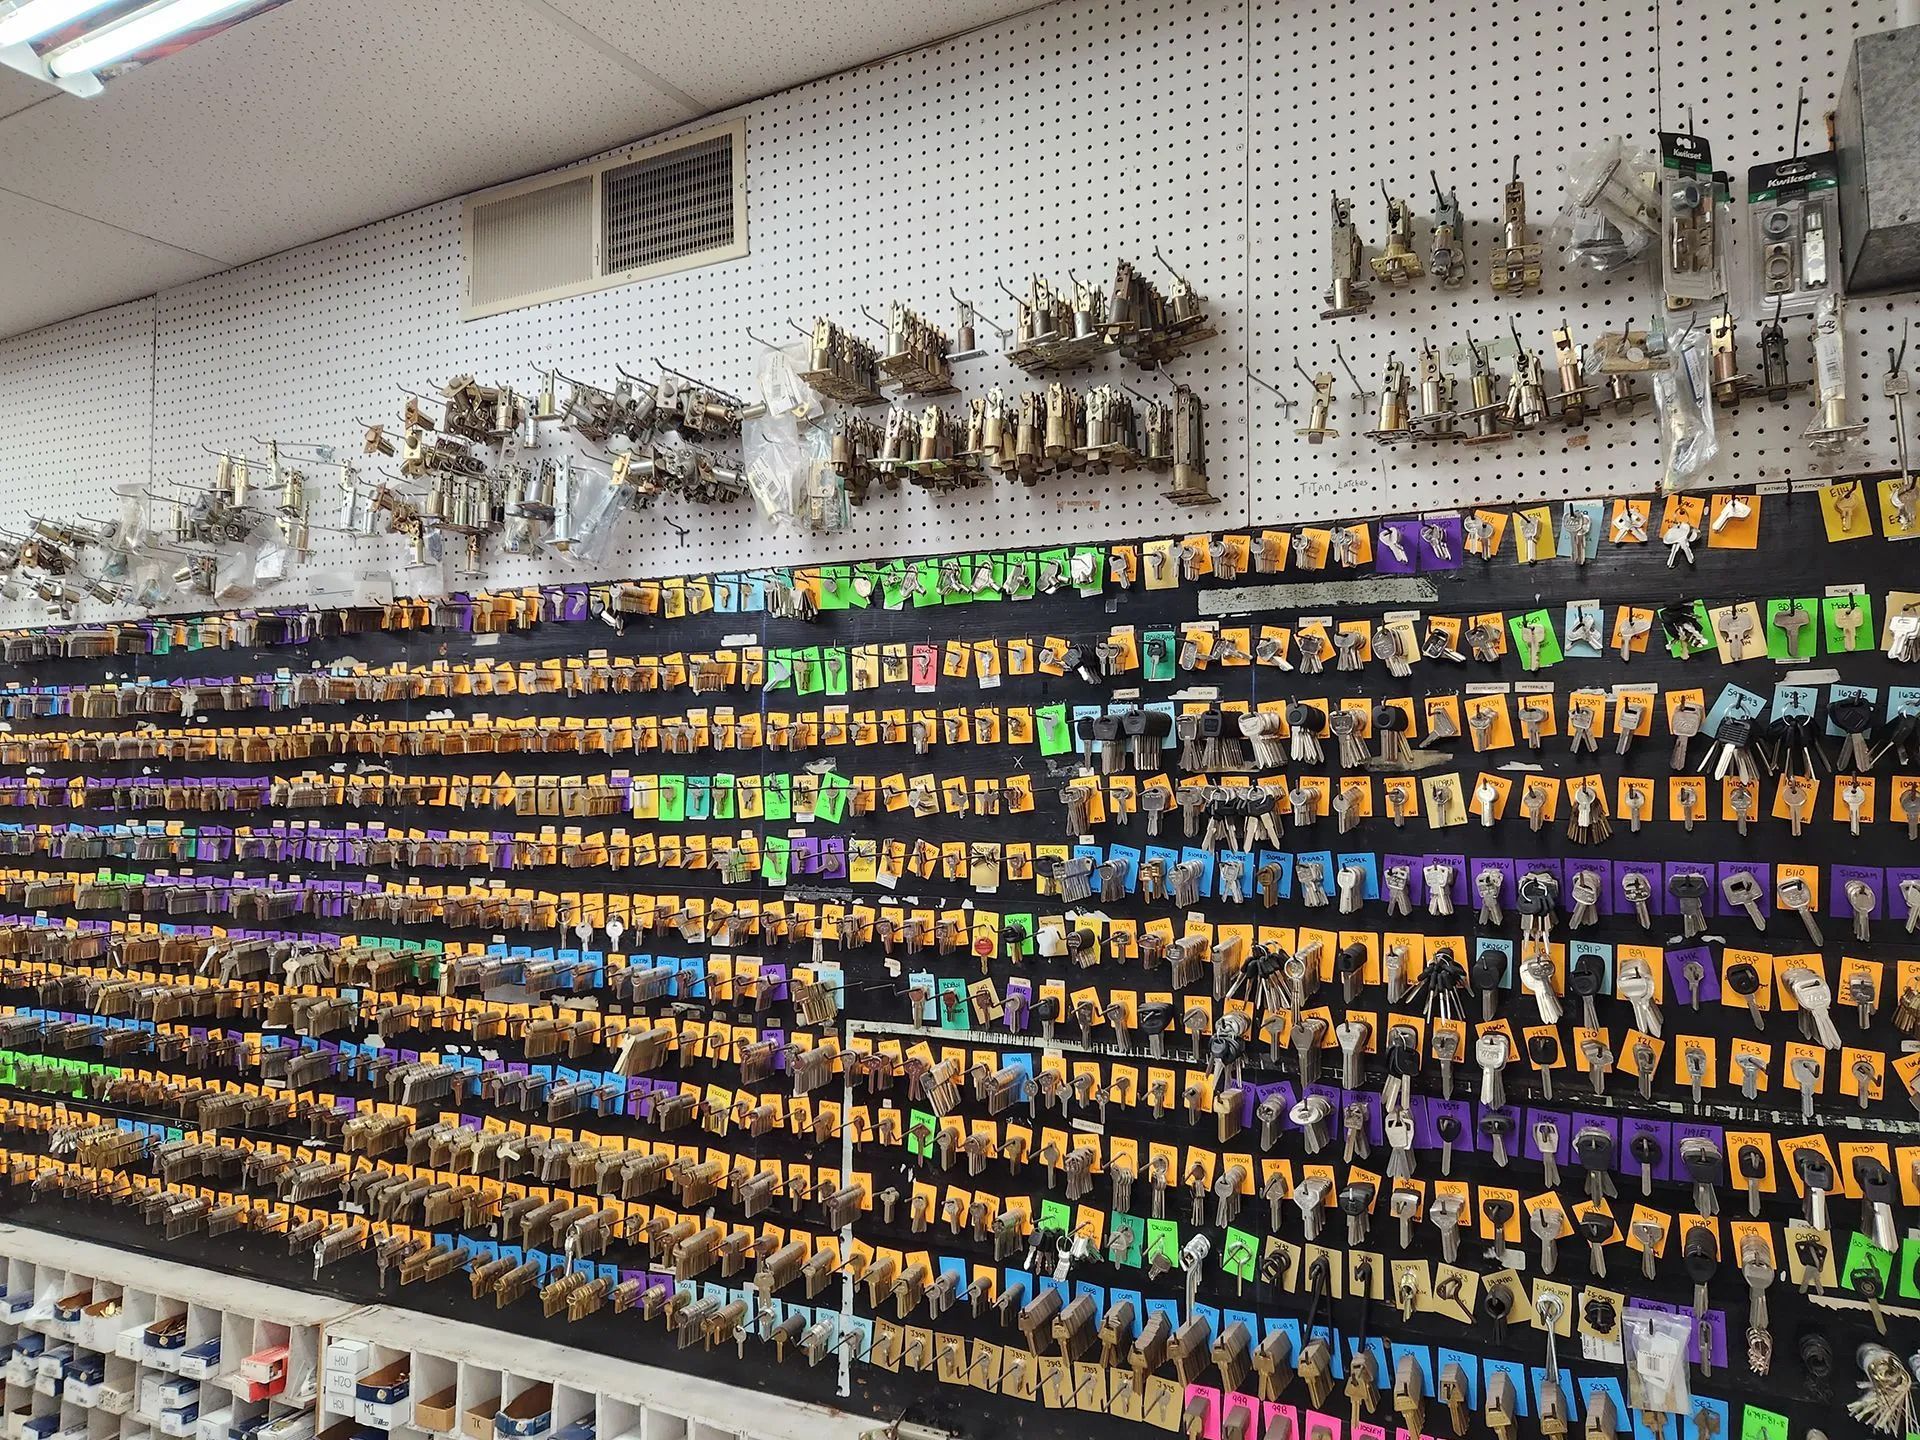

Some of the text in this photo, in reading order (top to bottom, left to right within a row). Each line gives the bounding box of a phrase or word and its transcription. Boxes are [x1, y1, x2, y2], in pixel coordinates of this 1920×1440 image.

[1673, 147, 1702, 160] Kwikset
[1767, 170, 1817, 188] Kwikset
[1785, 868, 1805, 877] B110
[1576, 944, 1601, 954] B91P
[1740, 1044, 1762, 1055] FC-3
[1794, 1048, 1814, 1057] FC-8
